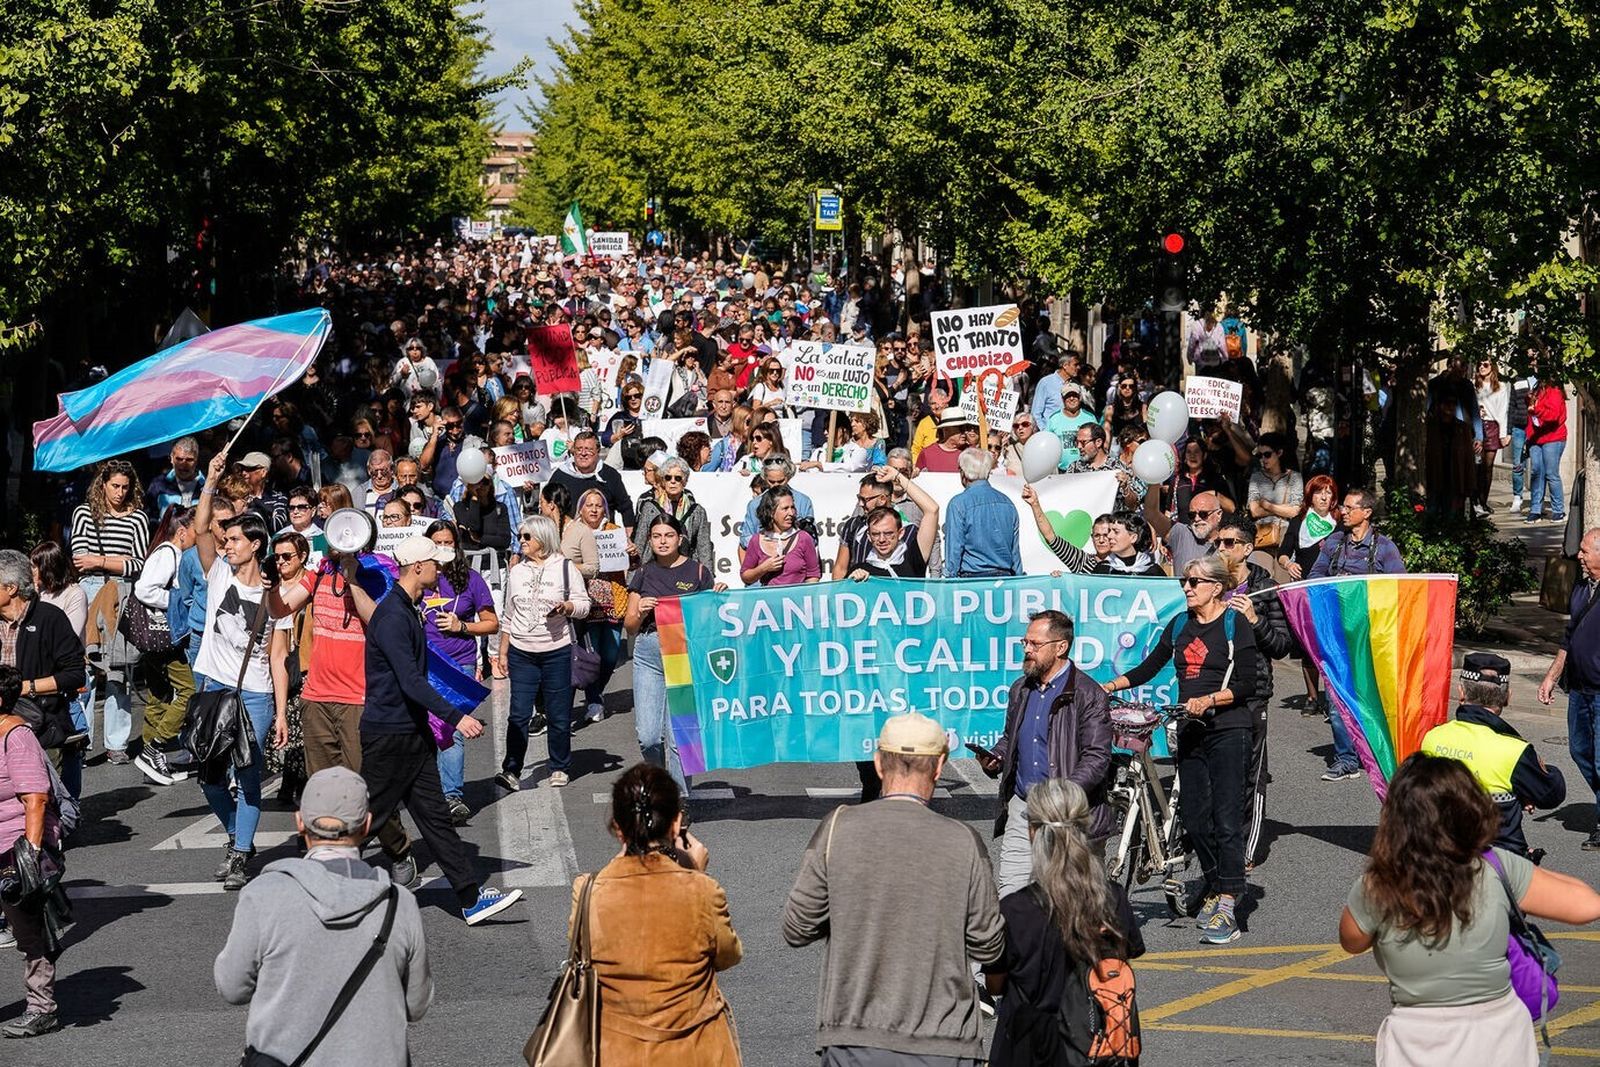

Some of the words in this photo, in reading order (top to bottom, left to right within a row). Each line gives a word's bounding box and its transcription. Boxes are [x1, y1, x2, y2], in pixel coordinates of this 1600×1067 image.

[937, 315, 963, 335] NO
[968, 312, 994, 327] HAY
[937, 334, 961, 355] PA'
[964, 329, 1019, 350] TANTO
[795, 346, 820, 364] La
[825, 350, 868, 367] salud
[795, 365, 815, 381] NO
[826, 371, 840, 380] un
[843, 369, 870, 385] LUJO
[792, 383, 803, 392] es
[808, 384, 820, 392] un
[822, 382, 868, 400] DERECHO
[1230, 393, 1240, 402] NO
[983, 398, 1008, 410] ERECE
[1219, 399, 1239, 411] NADIE
[967, 414, 1001, 427] DECNTE.
[496, 448, 546, 466] CONTRATOS
[506, 462, 540, 478] DIGNOS
[378, 532, 405, 540] ANIDAD
[718, 590, 936, 638] SANIDAD
[773, 643, 801, 677] Y
[819, 639, 880, 676] DE
[895, 636, 1104, 674] CALIDD
[712, 691, 793, 721] PARA
[799, 687, 916, 716] TODAS,
[924, 686, 1009, 711] TODO
